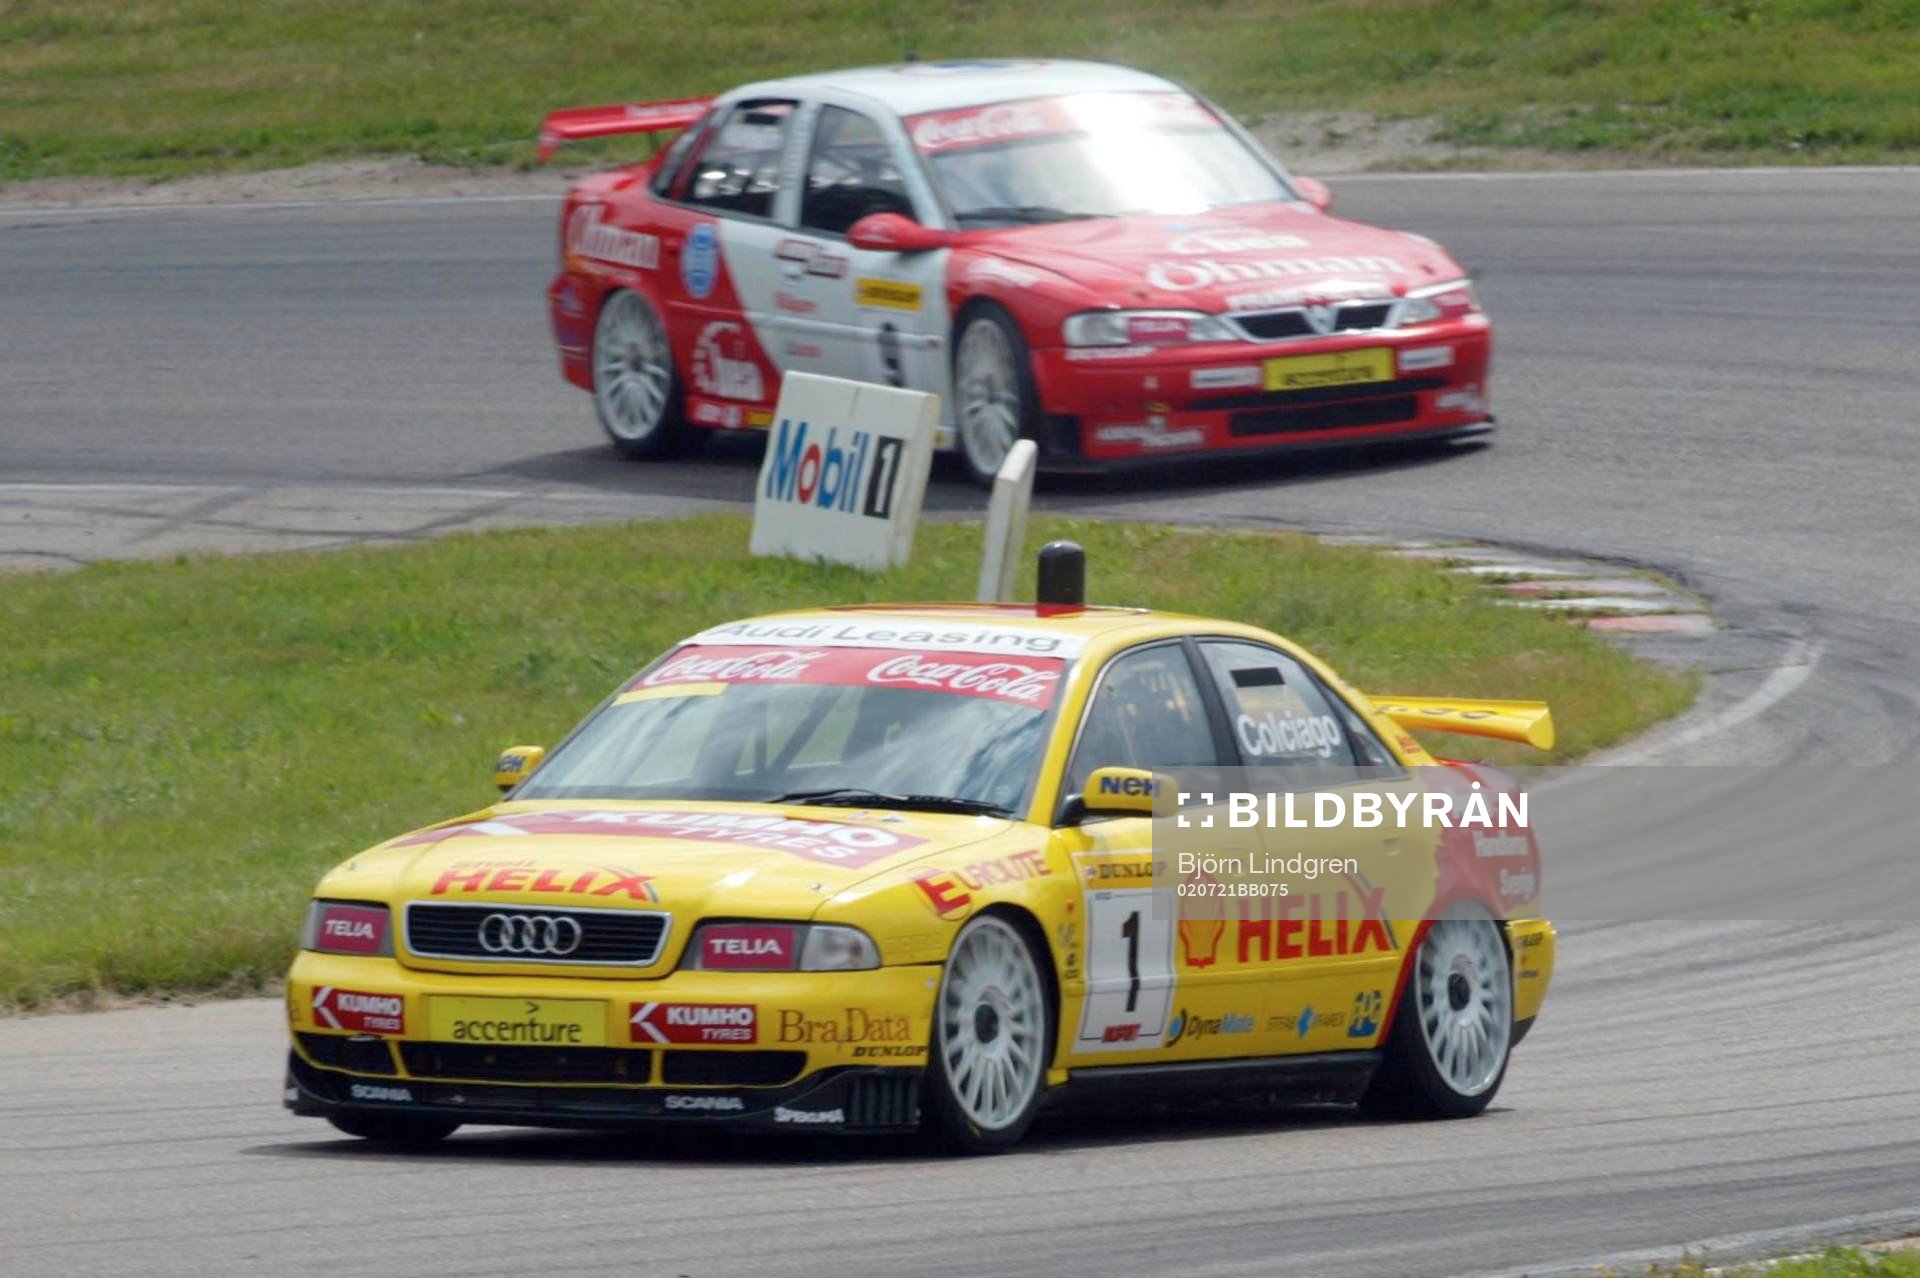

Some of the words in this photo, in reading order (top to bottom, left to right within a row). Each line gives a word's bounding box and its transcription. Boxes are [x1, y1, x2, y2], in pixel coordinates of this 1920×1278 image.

[767, 418, 870, 514] Mobil
[710, 624, 829, 640] Audi
[832, 624, 1062, 652] Leasing
[866, 655, 1061, 700] Coca-Cola
[1237, 709, 1341, 758] Colciago
[572, 812, 899, 848] KUMHO
[671, 827, 858, 859] TYRES
[431, 868, 656, 901] HELIX
[325, 919, 375, 939] TELIA
[1237, 886, 1392, 963] HELIX
[709, 938, 784, 955] TELIA
[1121, 910, 1141, 1013] 1
[336, 993, 402, 1017] KUMHO
[666, 1006, 754, 1026] KUMHO
[363, 1016, 400, 1030] TYRES
[453, 1017, 582, 1043] accenture
[701, 1027, 753, 1041] TYRES
[853, 1045, 929, 1057] DUNLOP
[664, 1095, 744, 1111] SCANIA
